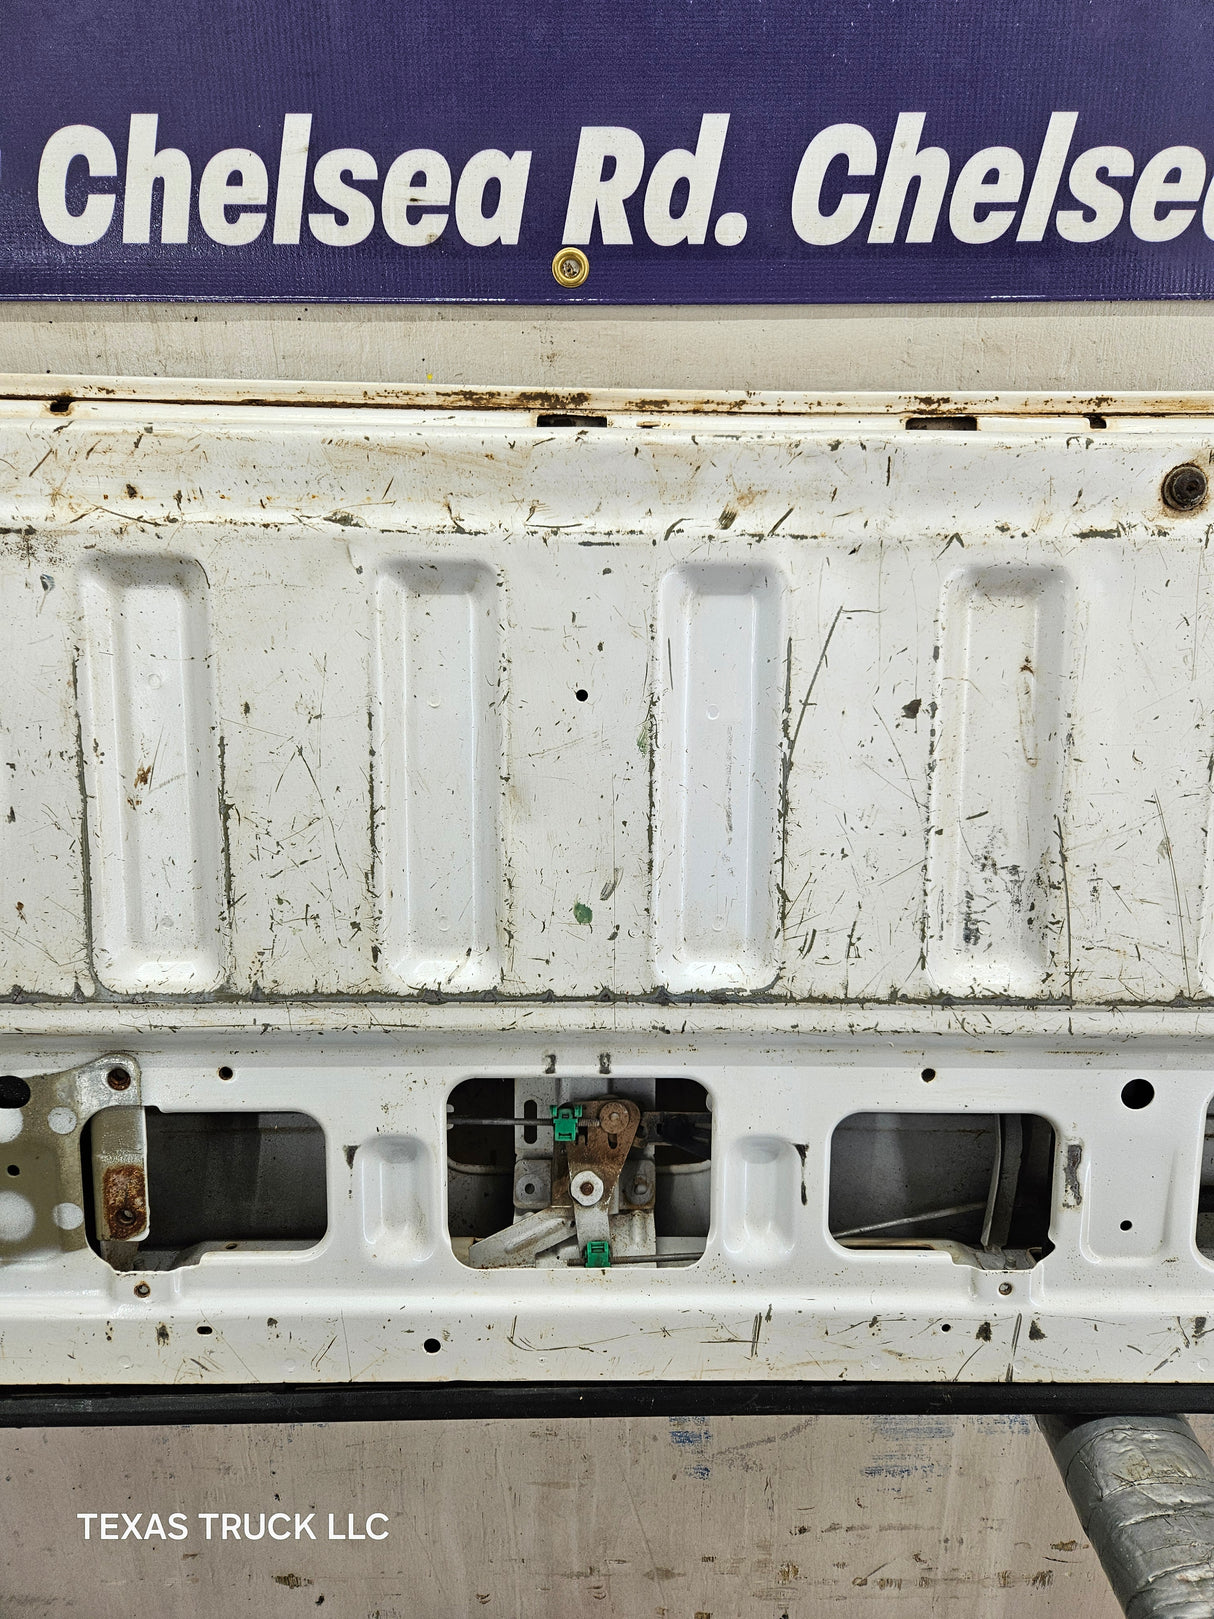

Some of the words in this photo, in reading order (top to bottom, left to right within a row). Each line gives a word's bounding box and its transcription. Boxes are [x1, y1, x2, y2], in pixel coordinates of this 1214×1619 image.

[37, 113, 532, 247] Chelsea
[561, 112, 748, 247] Rd.
[791, 111, 1214, 246] Chelse
